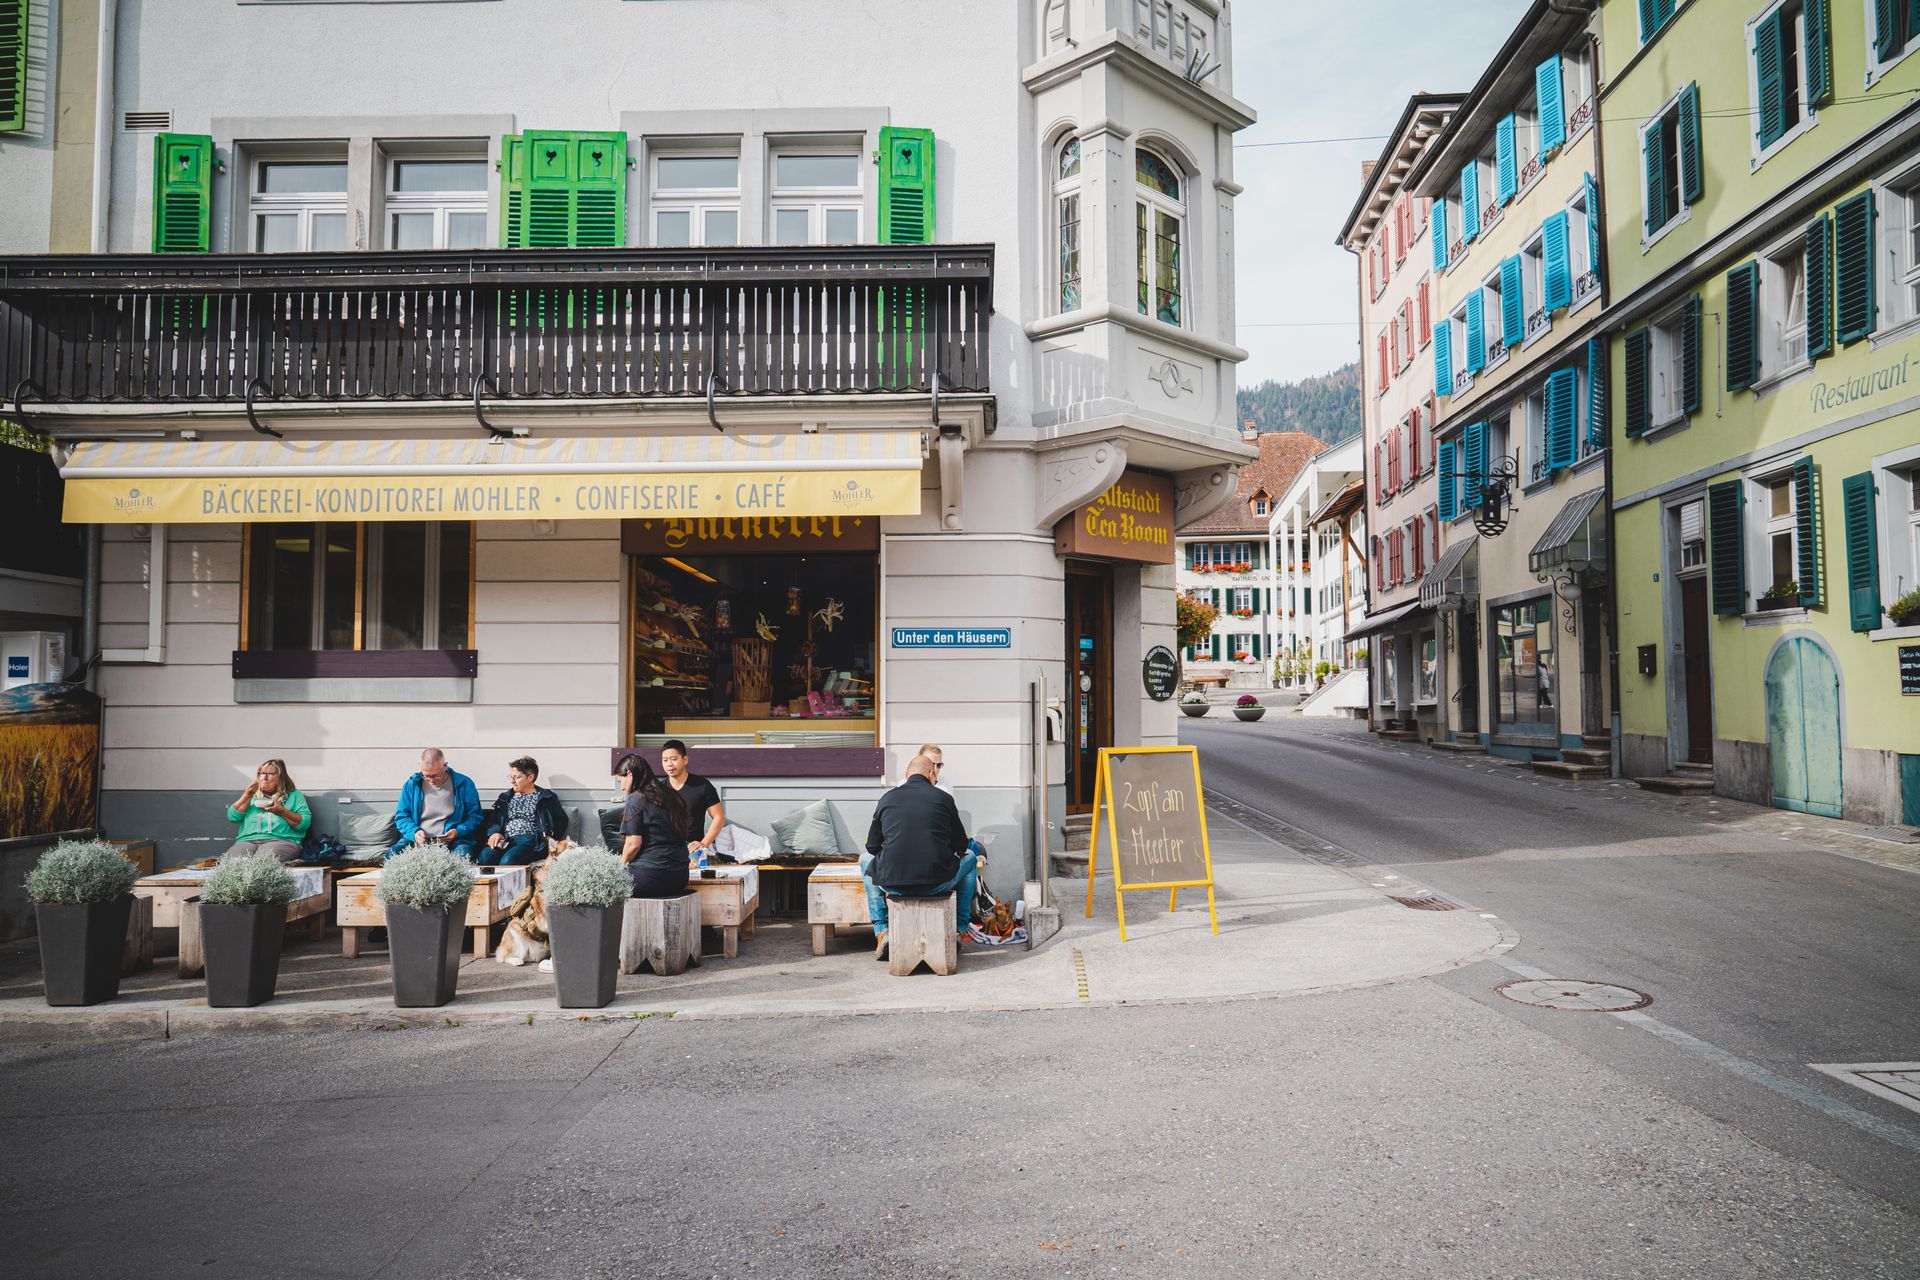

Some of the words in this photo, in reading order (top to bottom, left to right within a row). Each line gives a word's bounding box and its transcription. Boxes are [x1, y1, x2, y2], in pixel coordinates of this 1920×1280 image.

[202, 484, 443, 514] BÄCKEREI-KONDITOREI
[453, 486, 540, 512] MOHLER
[576, 484, 698, 510] CONFISERIE
[736, 476, 785, 508] CAFÉ
[1097, 485, 1160, 513] Altstadt
[1086, 506, 1117, 538] Tea
[1120, 513, 1167, 545] Room
[897, 631, 929, 643] Unter
[933, 631, 954, 643] den
[957, 631, 1006, 644] Häusern
[1123, 781, 1160, 822] Zopf
[1162, 789, 1185, 812] am
